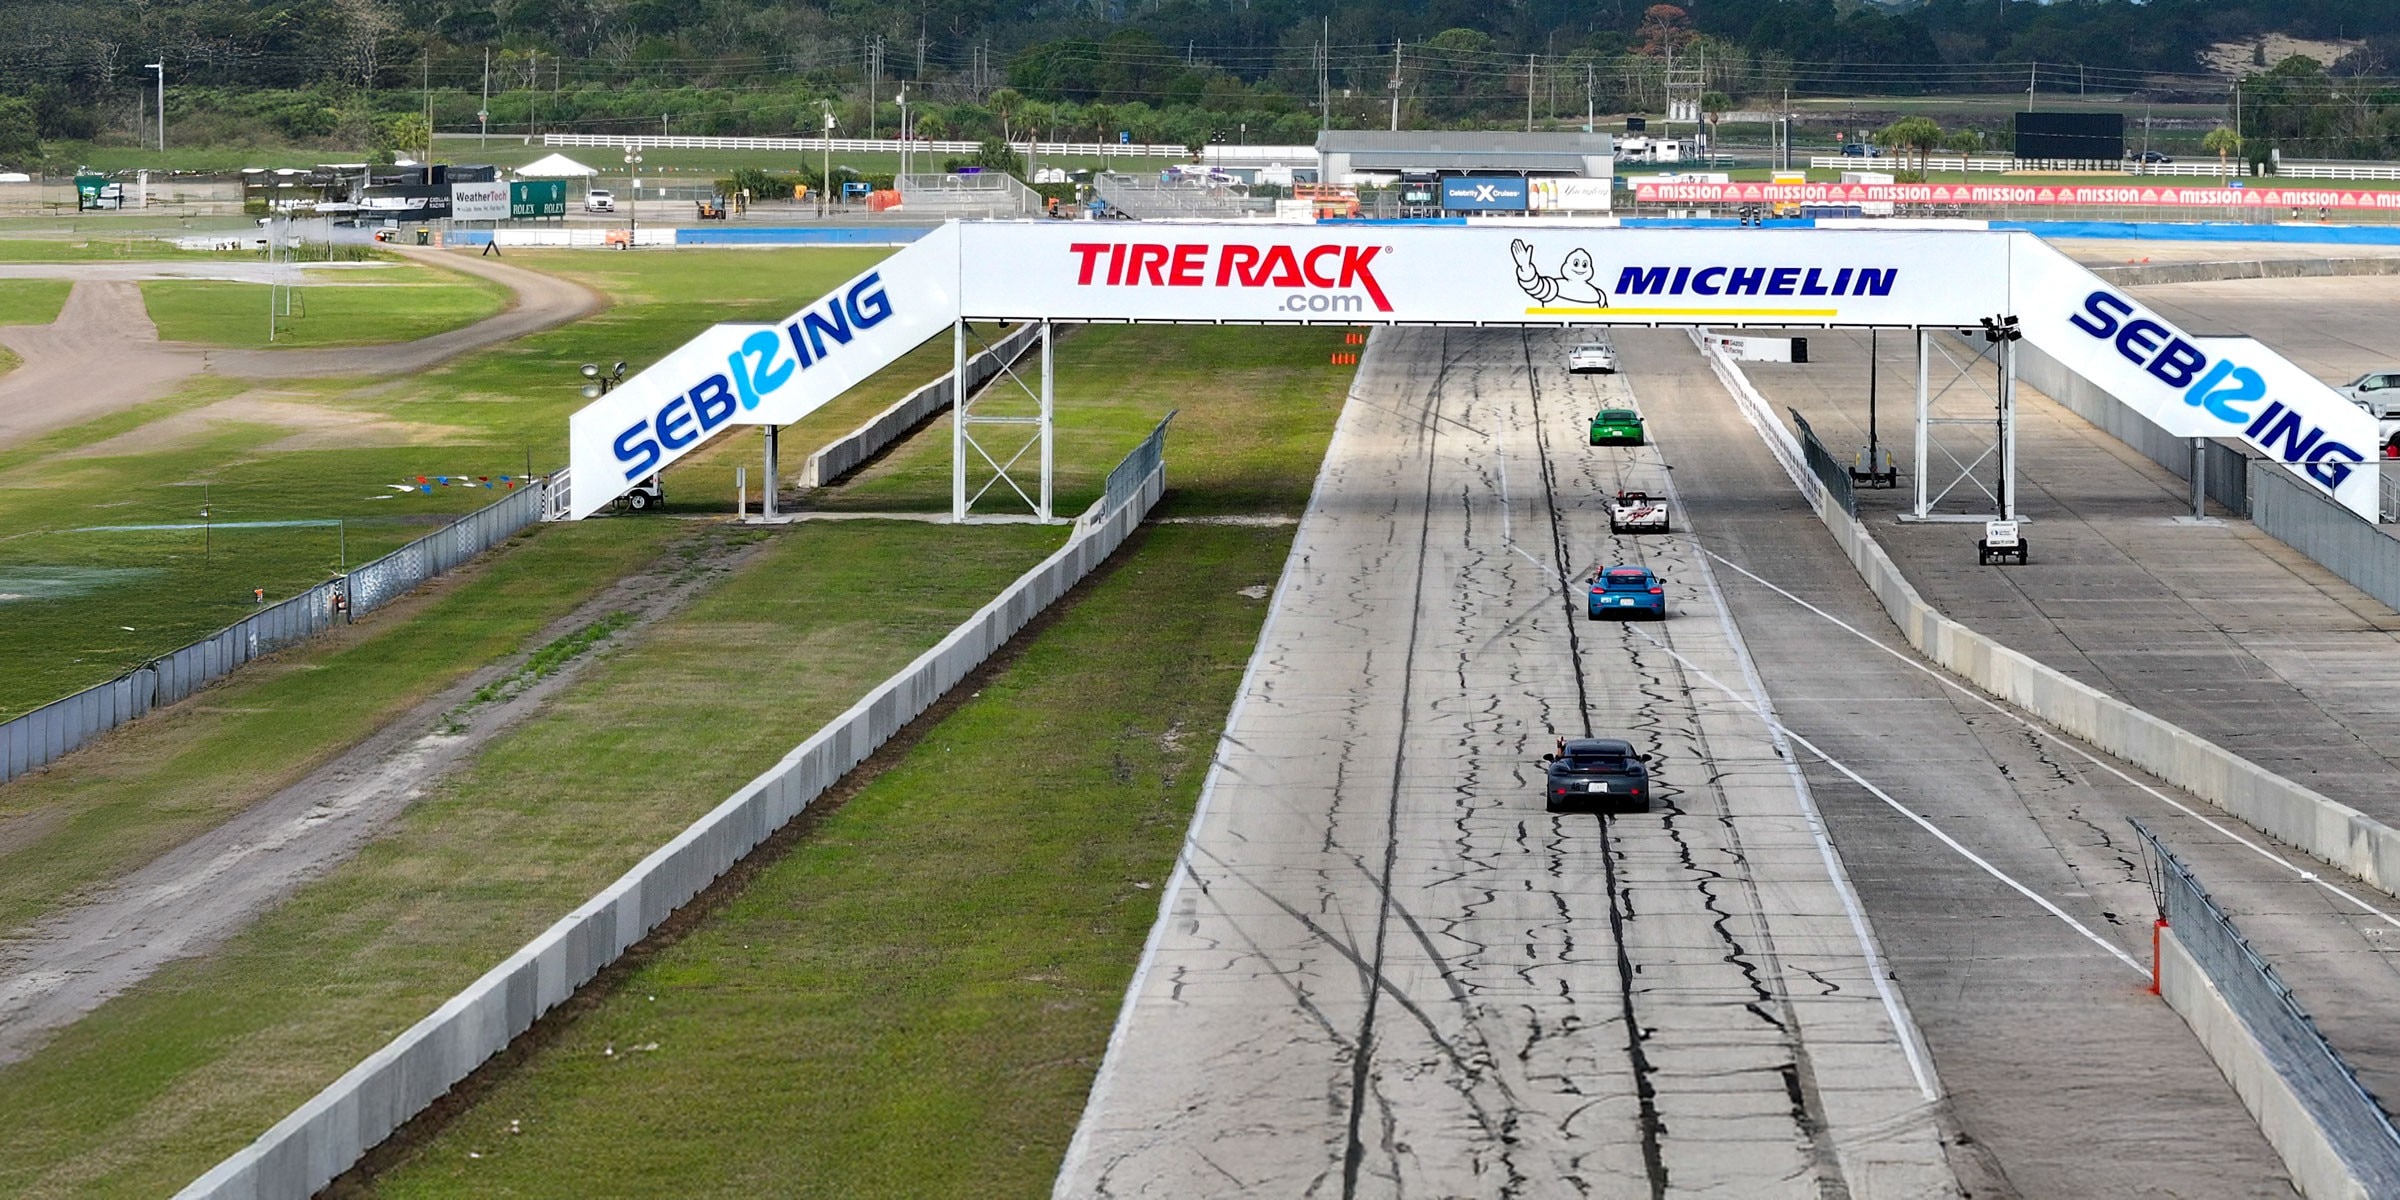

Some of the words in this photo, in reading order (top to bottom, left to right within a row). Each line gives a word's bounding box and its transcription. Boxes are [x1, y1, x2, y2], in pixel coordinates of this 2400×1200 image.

[456, 190, 507, 203] WeatherTech
[513, 204, 535, 214] ROLEX
[543, 203, 564, 213] ROLEX
[1070, 243, 1209, 287] TIRE
[1215, 244, 1394, 312] RACK
[1614, 266, 1898, 297] MICHELIN
[1278, 294, 1363, 312] .com
